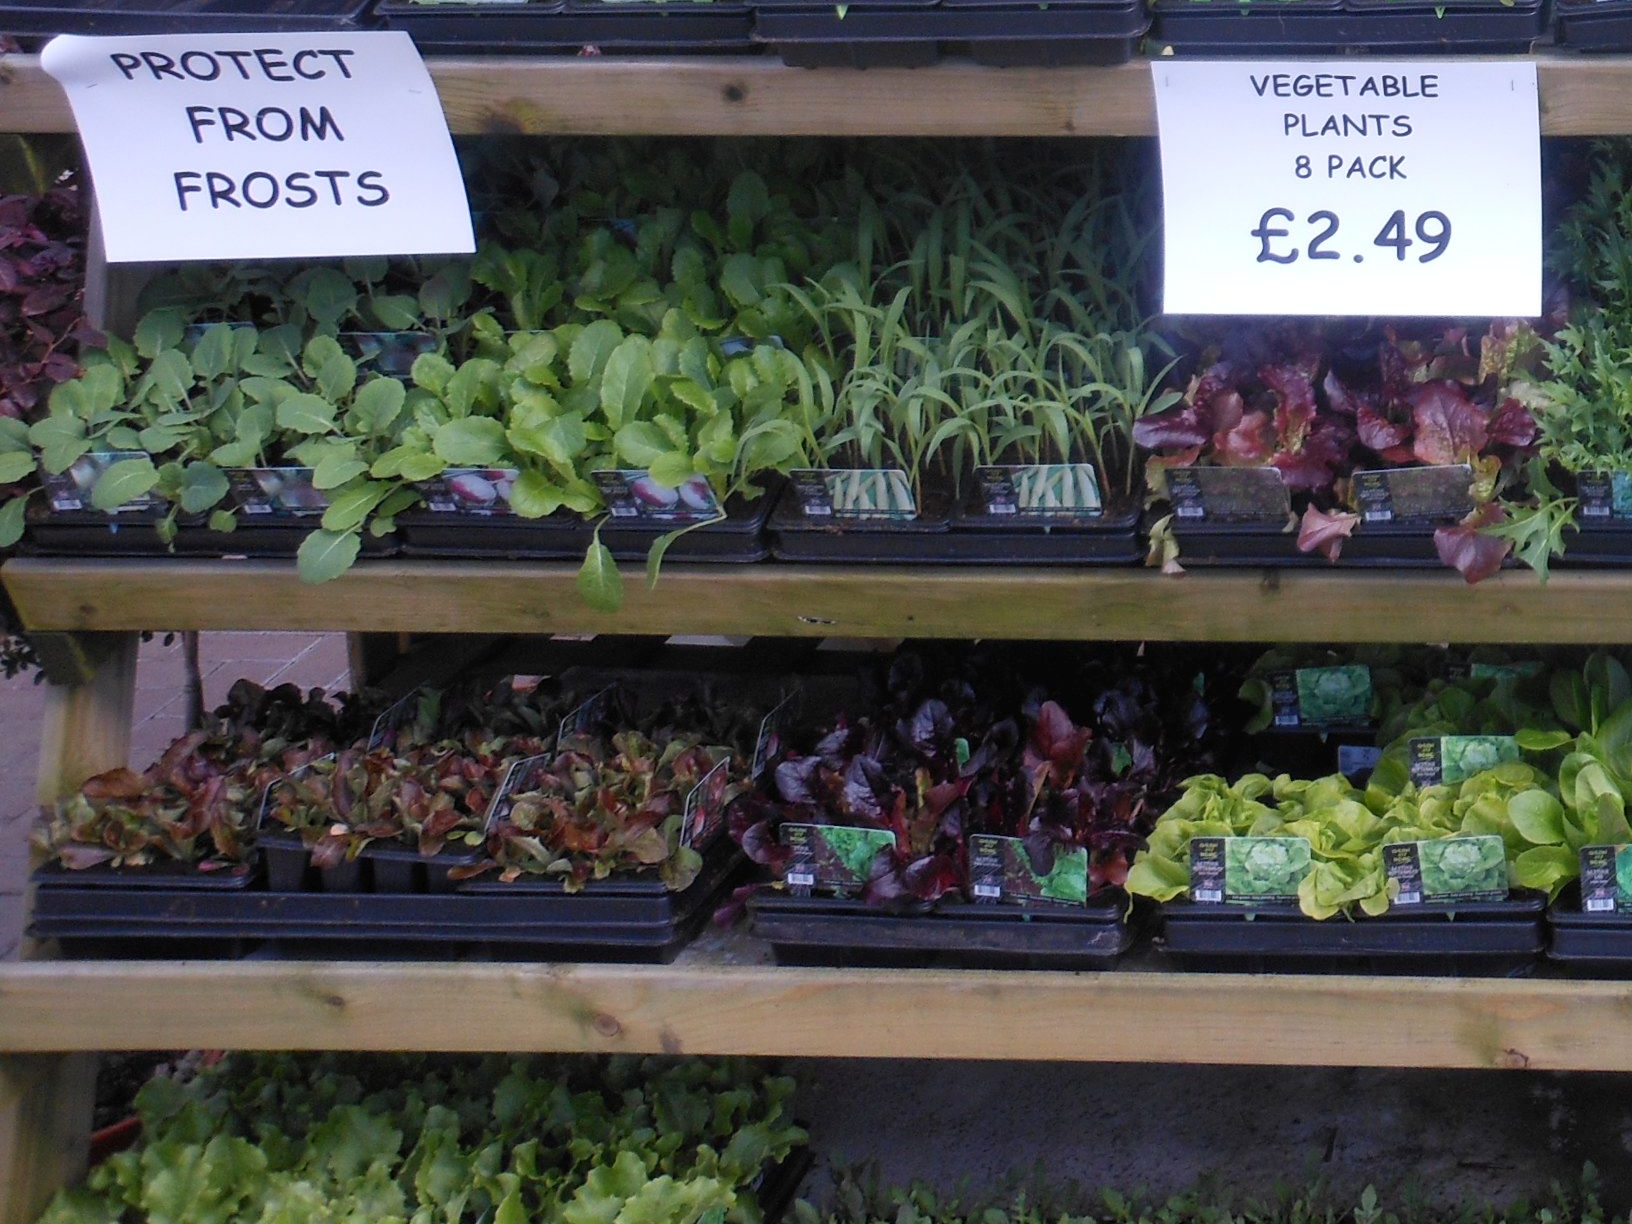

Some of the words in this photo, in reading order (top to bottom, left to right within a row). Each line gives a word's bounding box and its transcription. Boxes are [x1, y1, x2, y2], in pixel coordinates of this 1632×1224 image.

[110, 49, 354, 82] PROTECT
[1250, 75, 1439, 98] VEGETABLE
[185, 105, 344, 144] FROM
[1283, 113, 1413, 137] PLANTS
[1295, 155, 1312, 179] 8
[1328, 155, 1407, 180] PACK
[173, 170, 390, 212] FROSTS
[1250, 207, 1452, 264] £2.49
